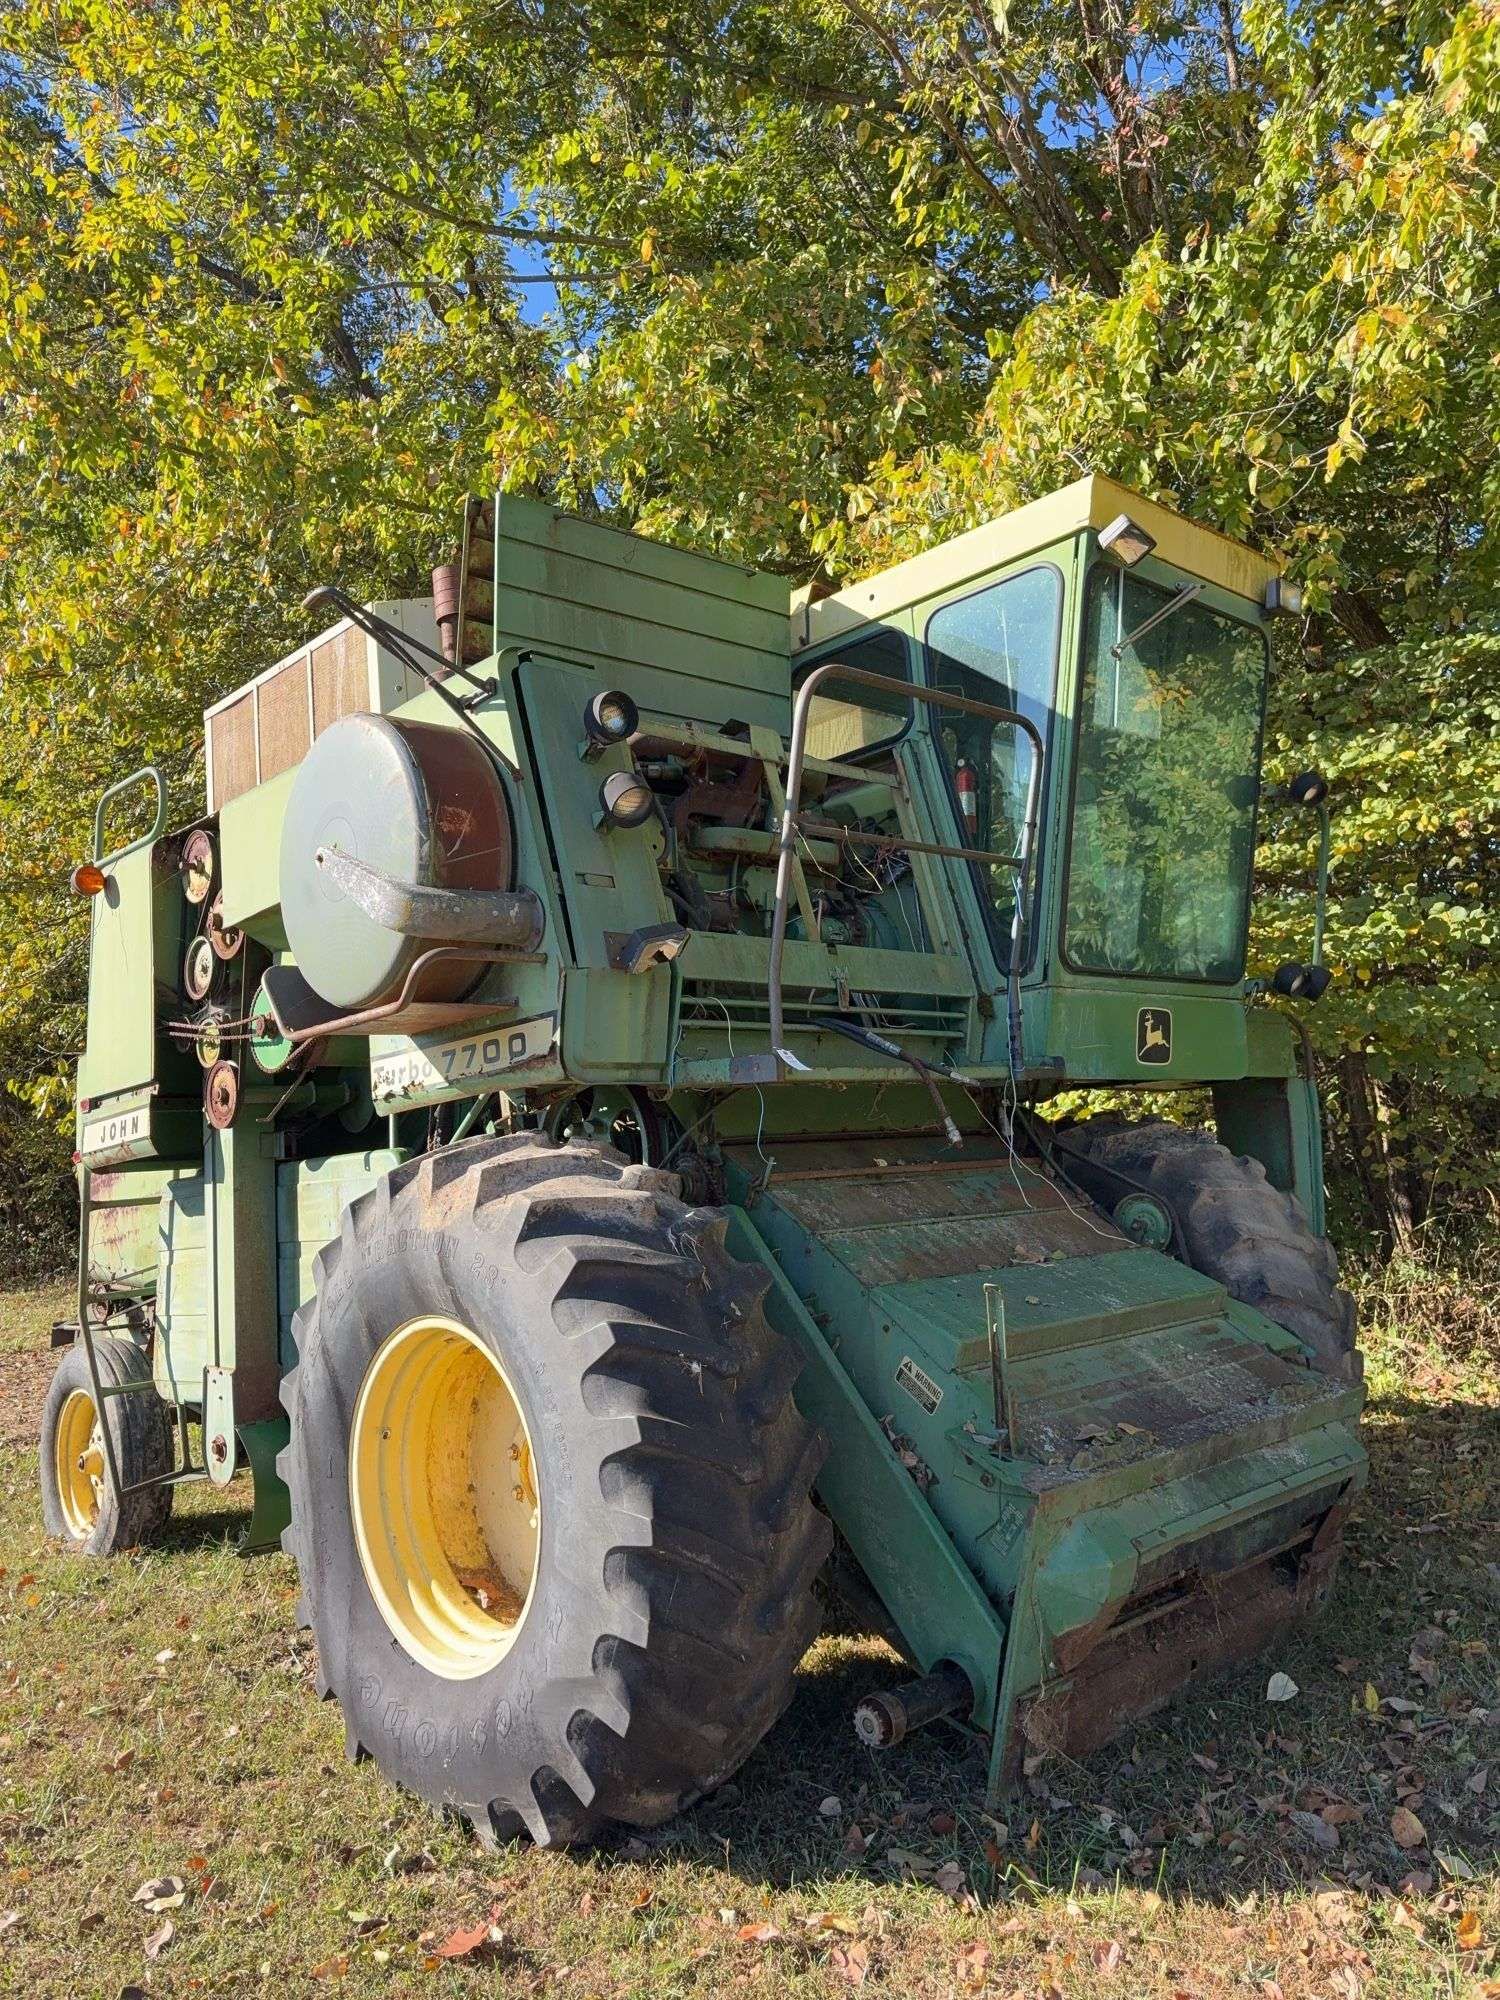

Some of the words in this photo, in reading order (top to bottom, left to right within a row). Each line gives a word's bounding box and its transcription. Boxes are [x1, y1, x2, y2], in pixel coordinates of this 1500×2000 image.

[441, 1031, 527, 1074] 7700
[100, 1115, 139, 1143] JOHN
[914, 1369, 942, 1400] WARNING
